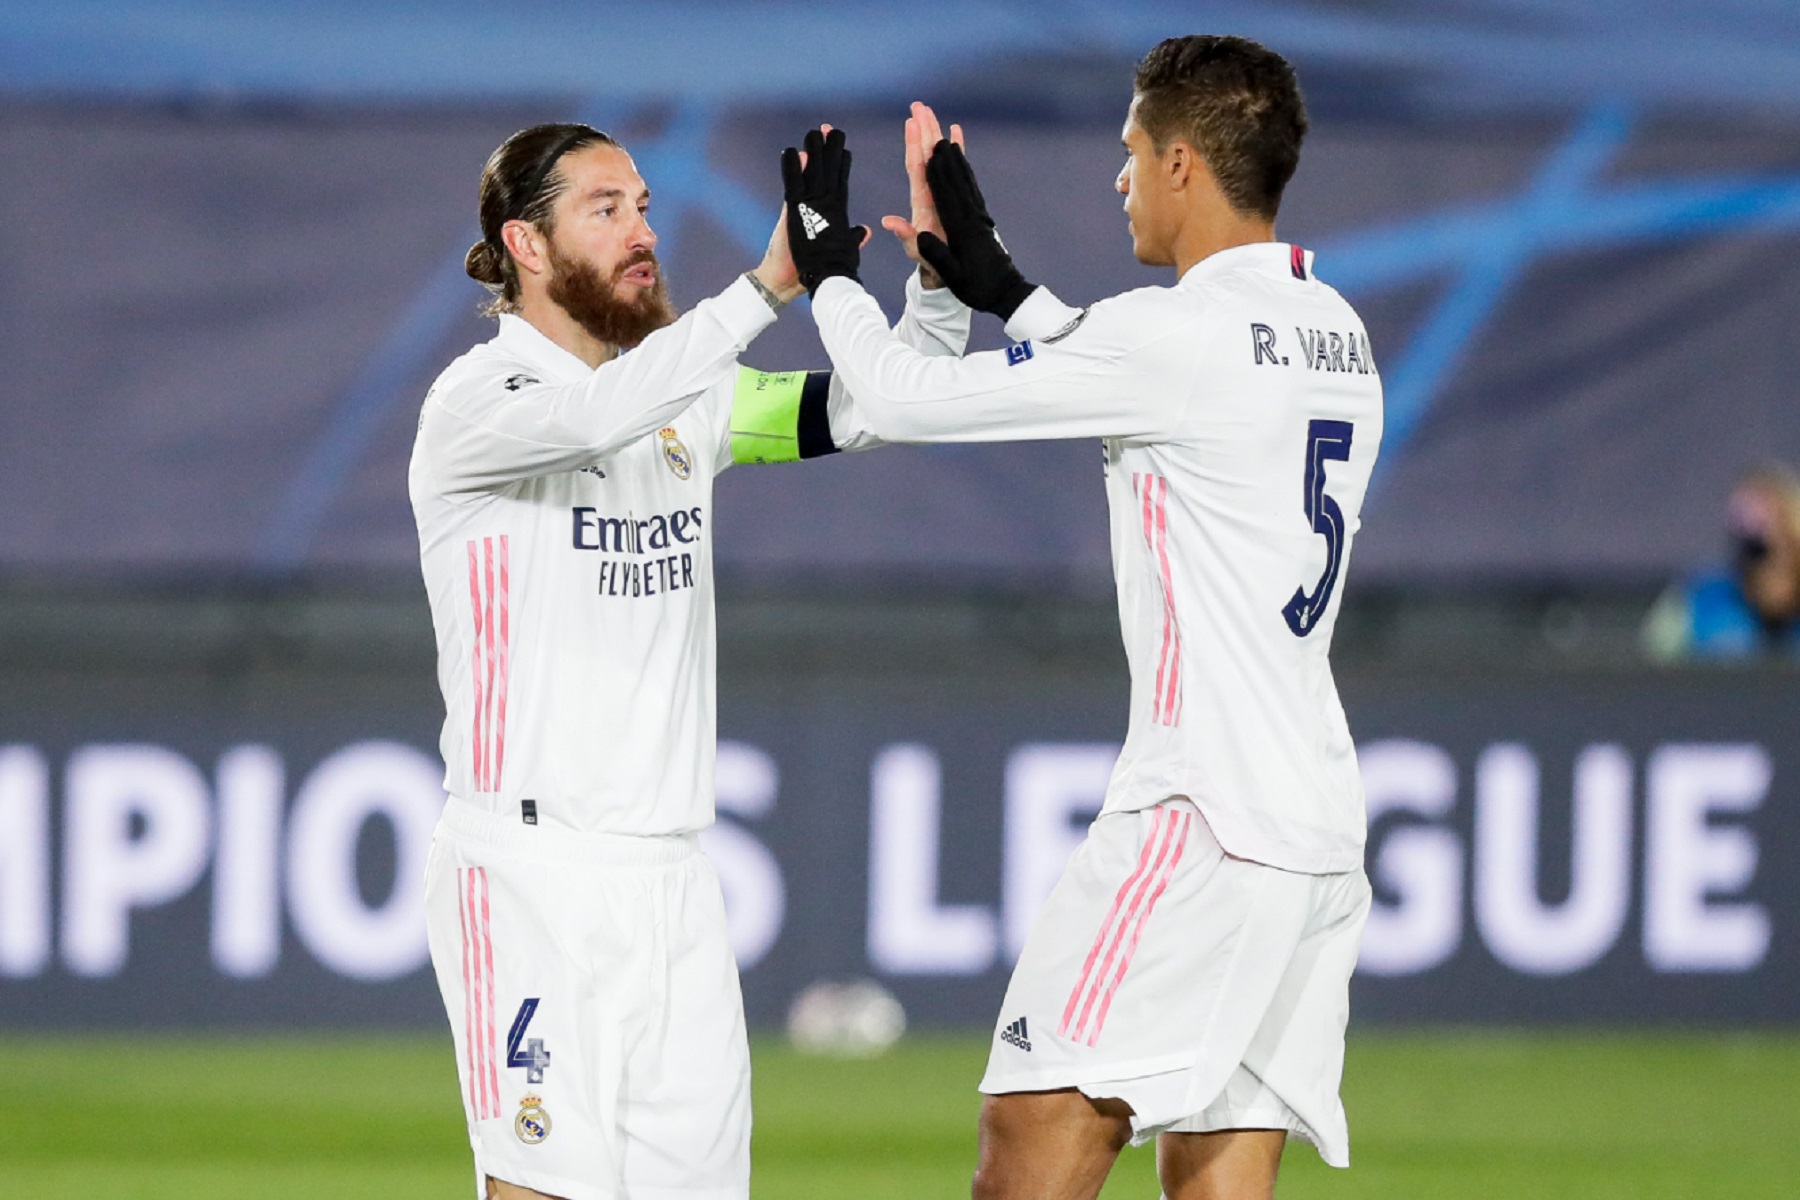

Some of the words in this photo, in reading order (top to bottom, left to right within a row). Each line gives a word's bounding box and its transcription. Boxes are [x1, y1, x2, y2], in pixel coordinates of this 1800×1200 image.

[1250, 322, 1290, 366] R.
[572, 506, 702, 554] Emiraes
[1281, 419, 1354, 637] 5
[0, 739, 788, 980] PIOS
[863, 740, 1774, 977] LEGUE
[507, 998, 551, 1084] 4
[1001, 1030, 1032, 1052] adidas
